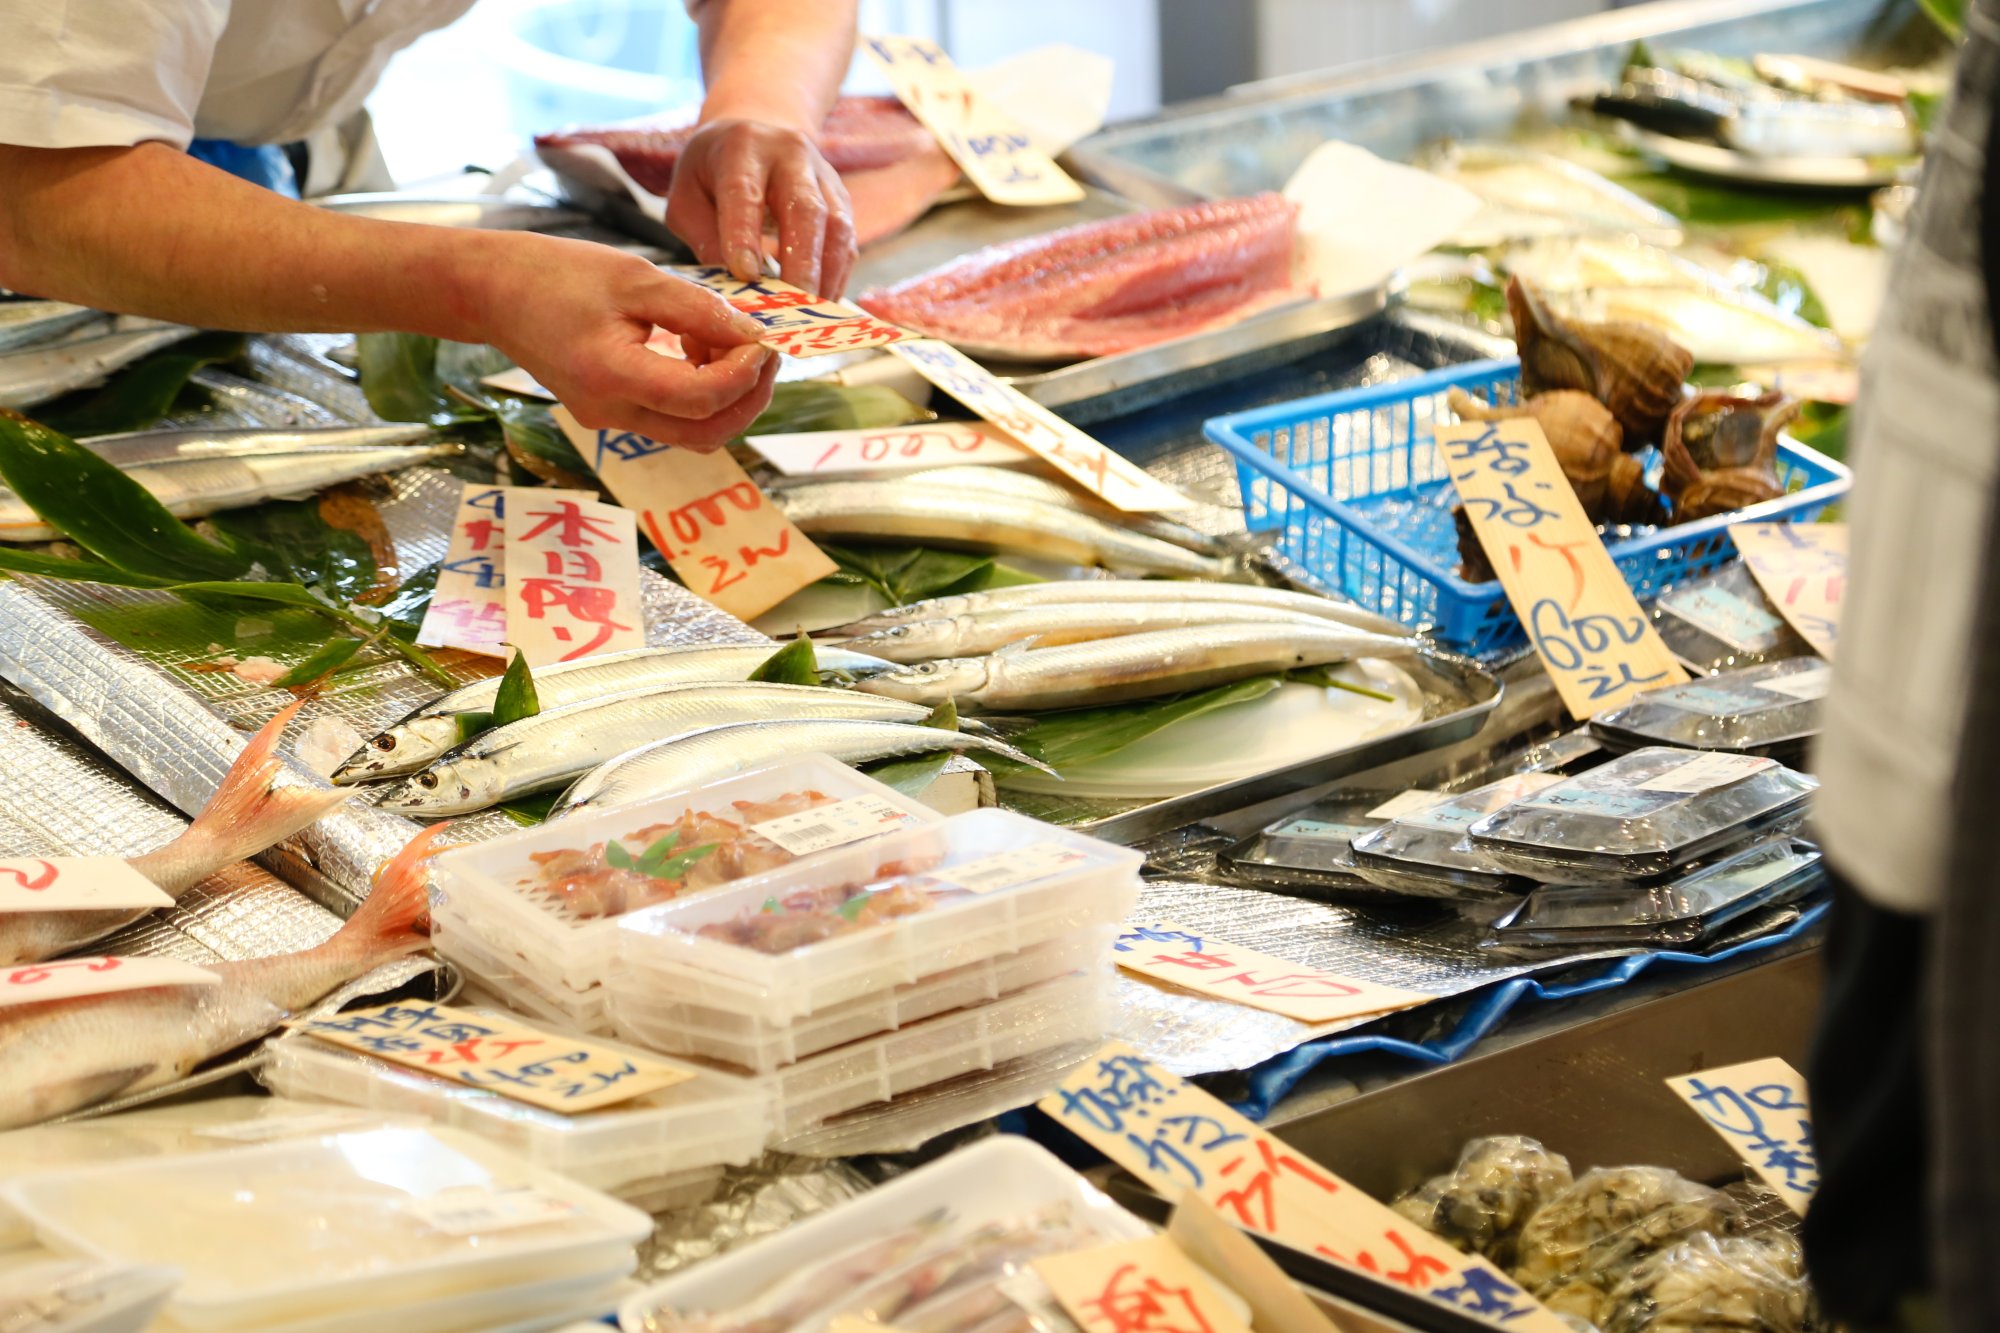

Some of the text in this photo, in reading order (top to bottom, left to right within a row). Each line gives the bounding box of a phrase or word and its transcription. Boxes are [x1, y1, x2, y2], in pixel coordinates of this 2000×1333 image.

[517, 500, 633, 662] 本日限り
[1529, 598, 1645, 671] 600
